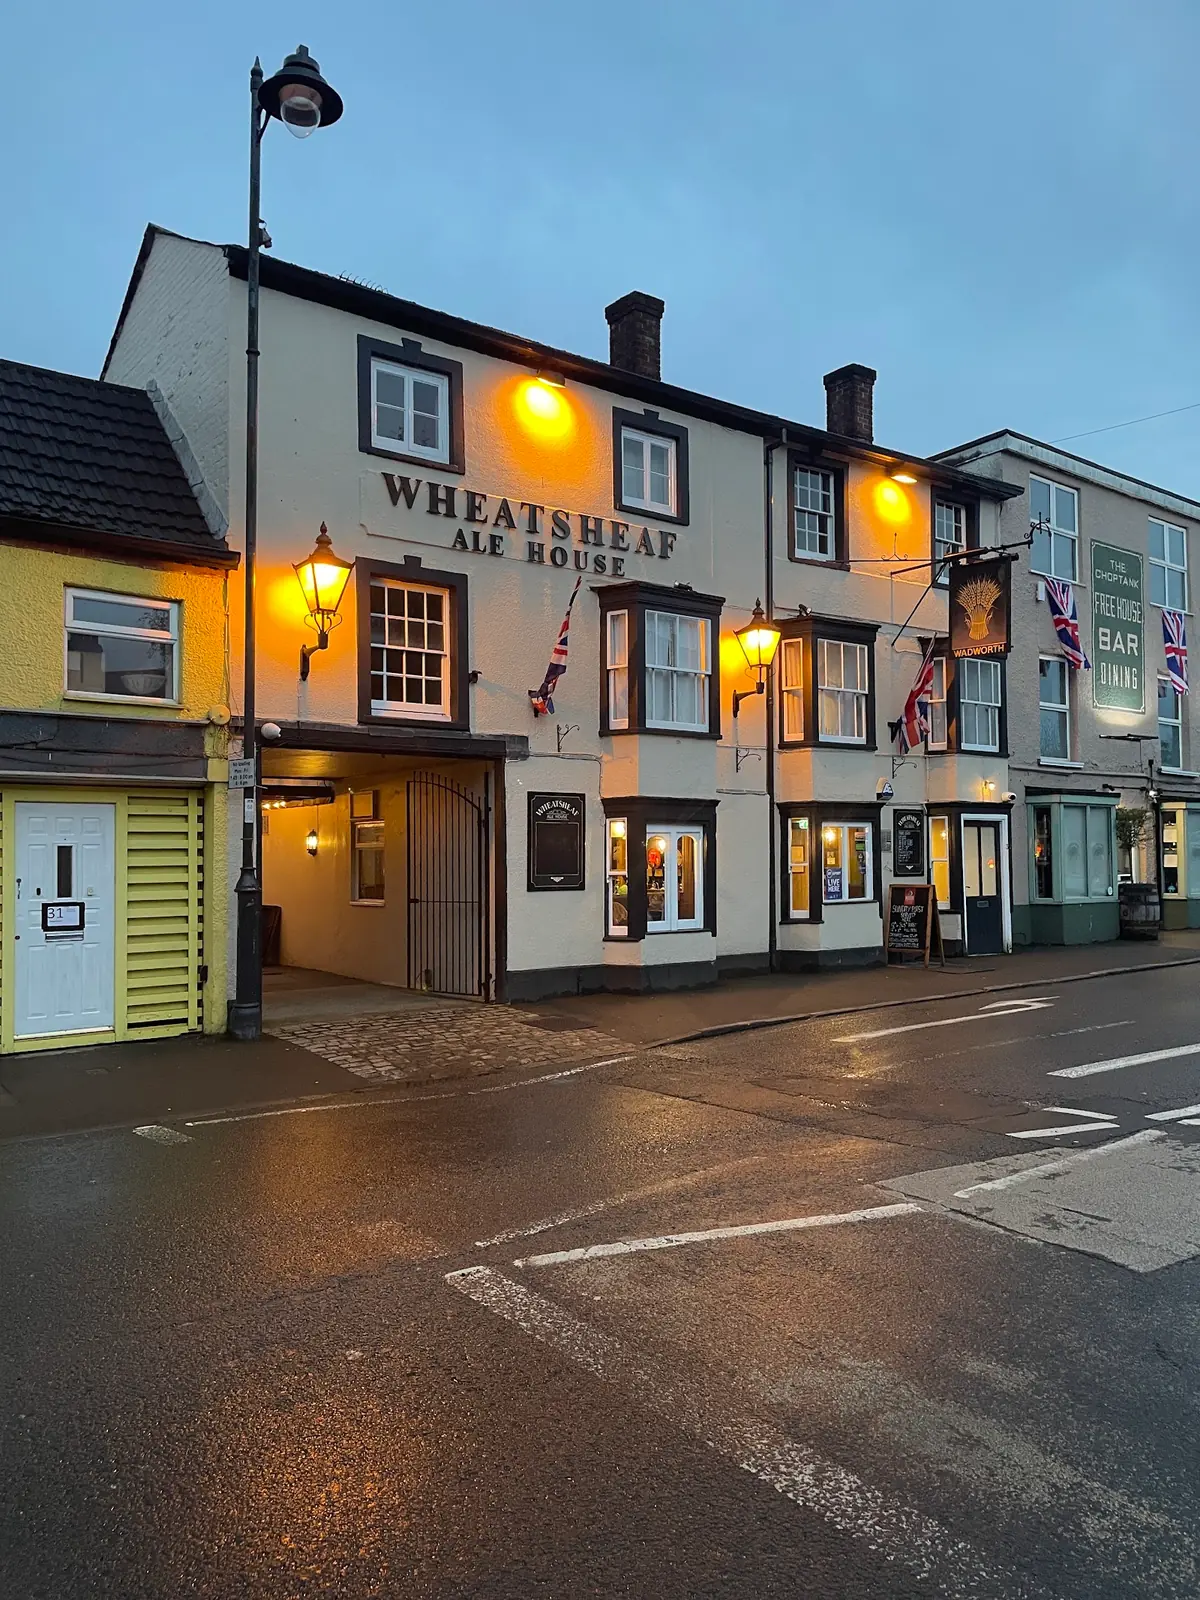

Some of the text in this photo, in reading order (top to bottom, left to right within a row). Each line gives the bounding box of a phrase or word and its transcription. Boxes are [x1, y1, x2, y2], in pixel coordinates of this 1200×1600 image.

[381, 472, 677, 559] WHEATSHEAF
[452, 528, 625, 577] ALE HOUSE
[1109, 560, 1127, 574] THE
[1095, 569, 1140, 589] CHOPTANK
[1095, 592, 1142, 624] FREE HOUSE
[953, 643, 1005, 657] WADWORTH
[1099, 627, 1138, 656] BAR
[1100, 662, 1138, 689] DINING
[535, 800, 580, 816] WHEATSHEAF
[828, 878, 840, 887] LIVE
[48, 907, 64, 918] 31
